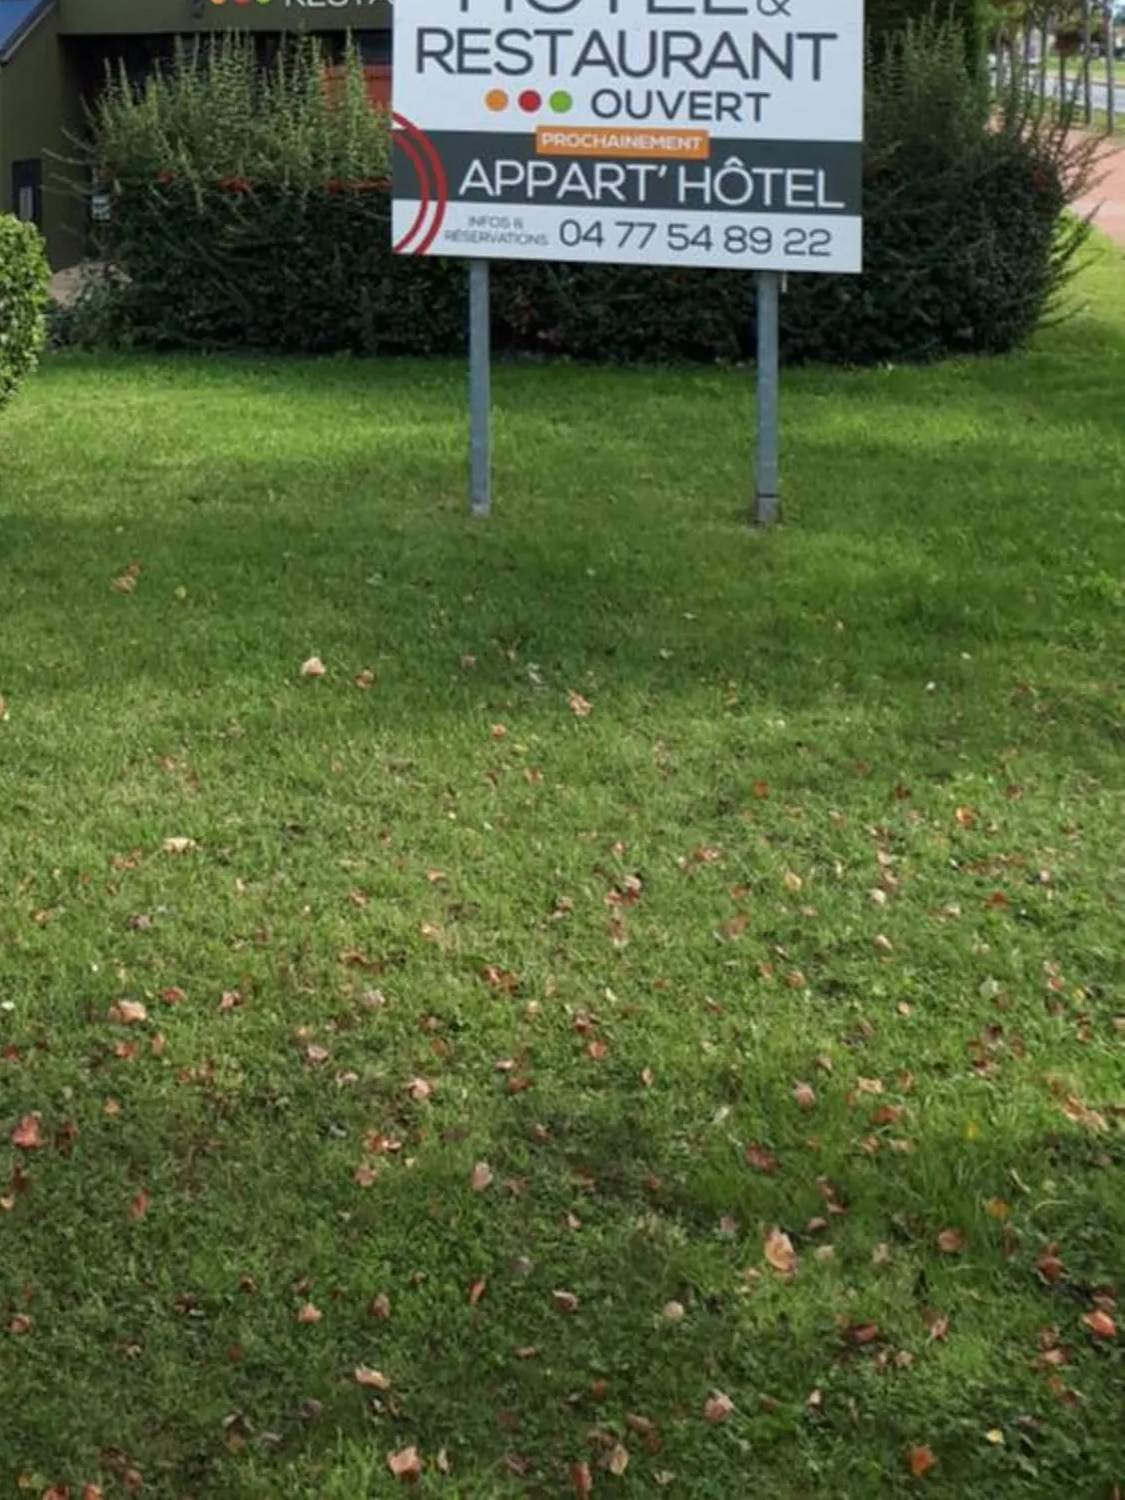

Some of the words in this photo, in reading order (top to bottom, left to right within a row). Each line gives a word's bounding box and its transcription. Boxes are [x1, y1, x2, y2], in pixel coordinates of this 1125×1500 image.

[415, 27, 839, 83] RESTAURANT
[590, 87, 771, 123] OUVERT
[540, 131, 705, 154] PROCHAINEMENT
[467, 215, 510, 229] INFOS
[558, 218, 606, 248] 04
[616, 222, 658, 250] 77
[666, 223, 714, 253] 54
[723, 225, 773, 256] 89
[783, 227, 832, 258] 22
